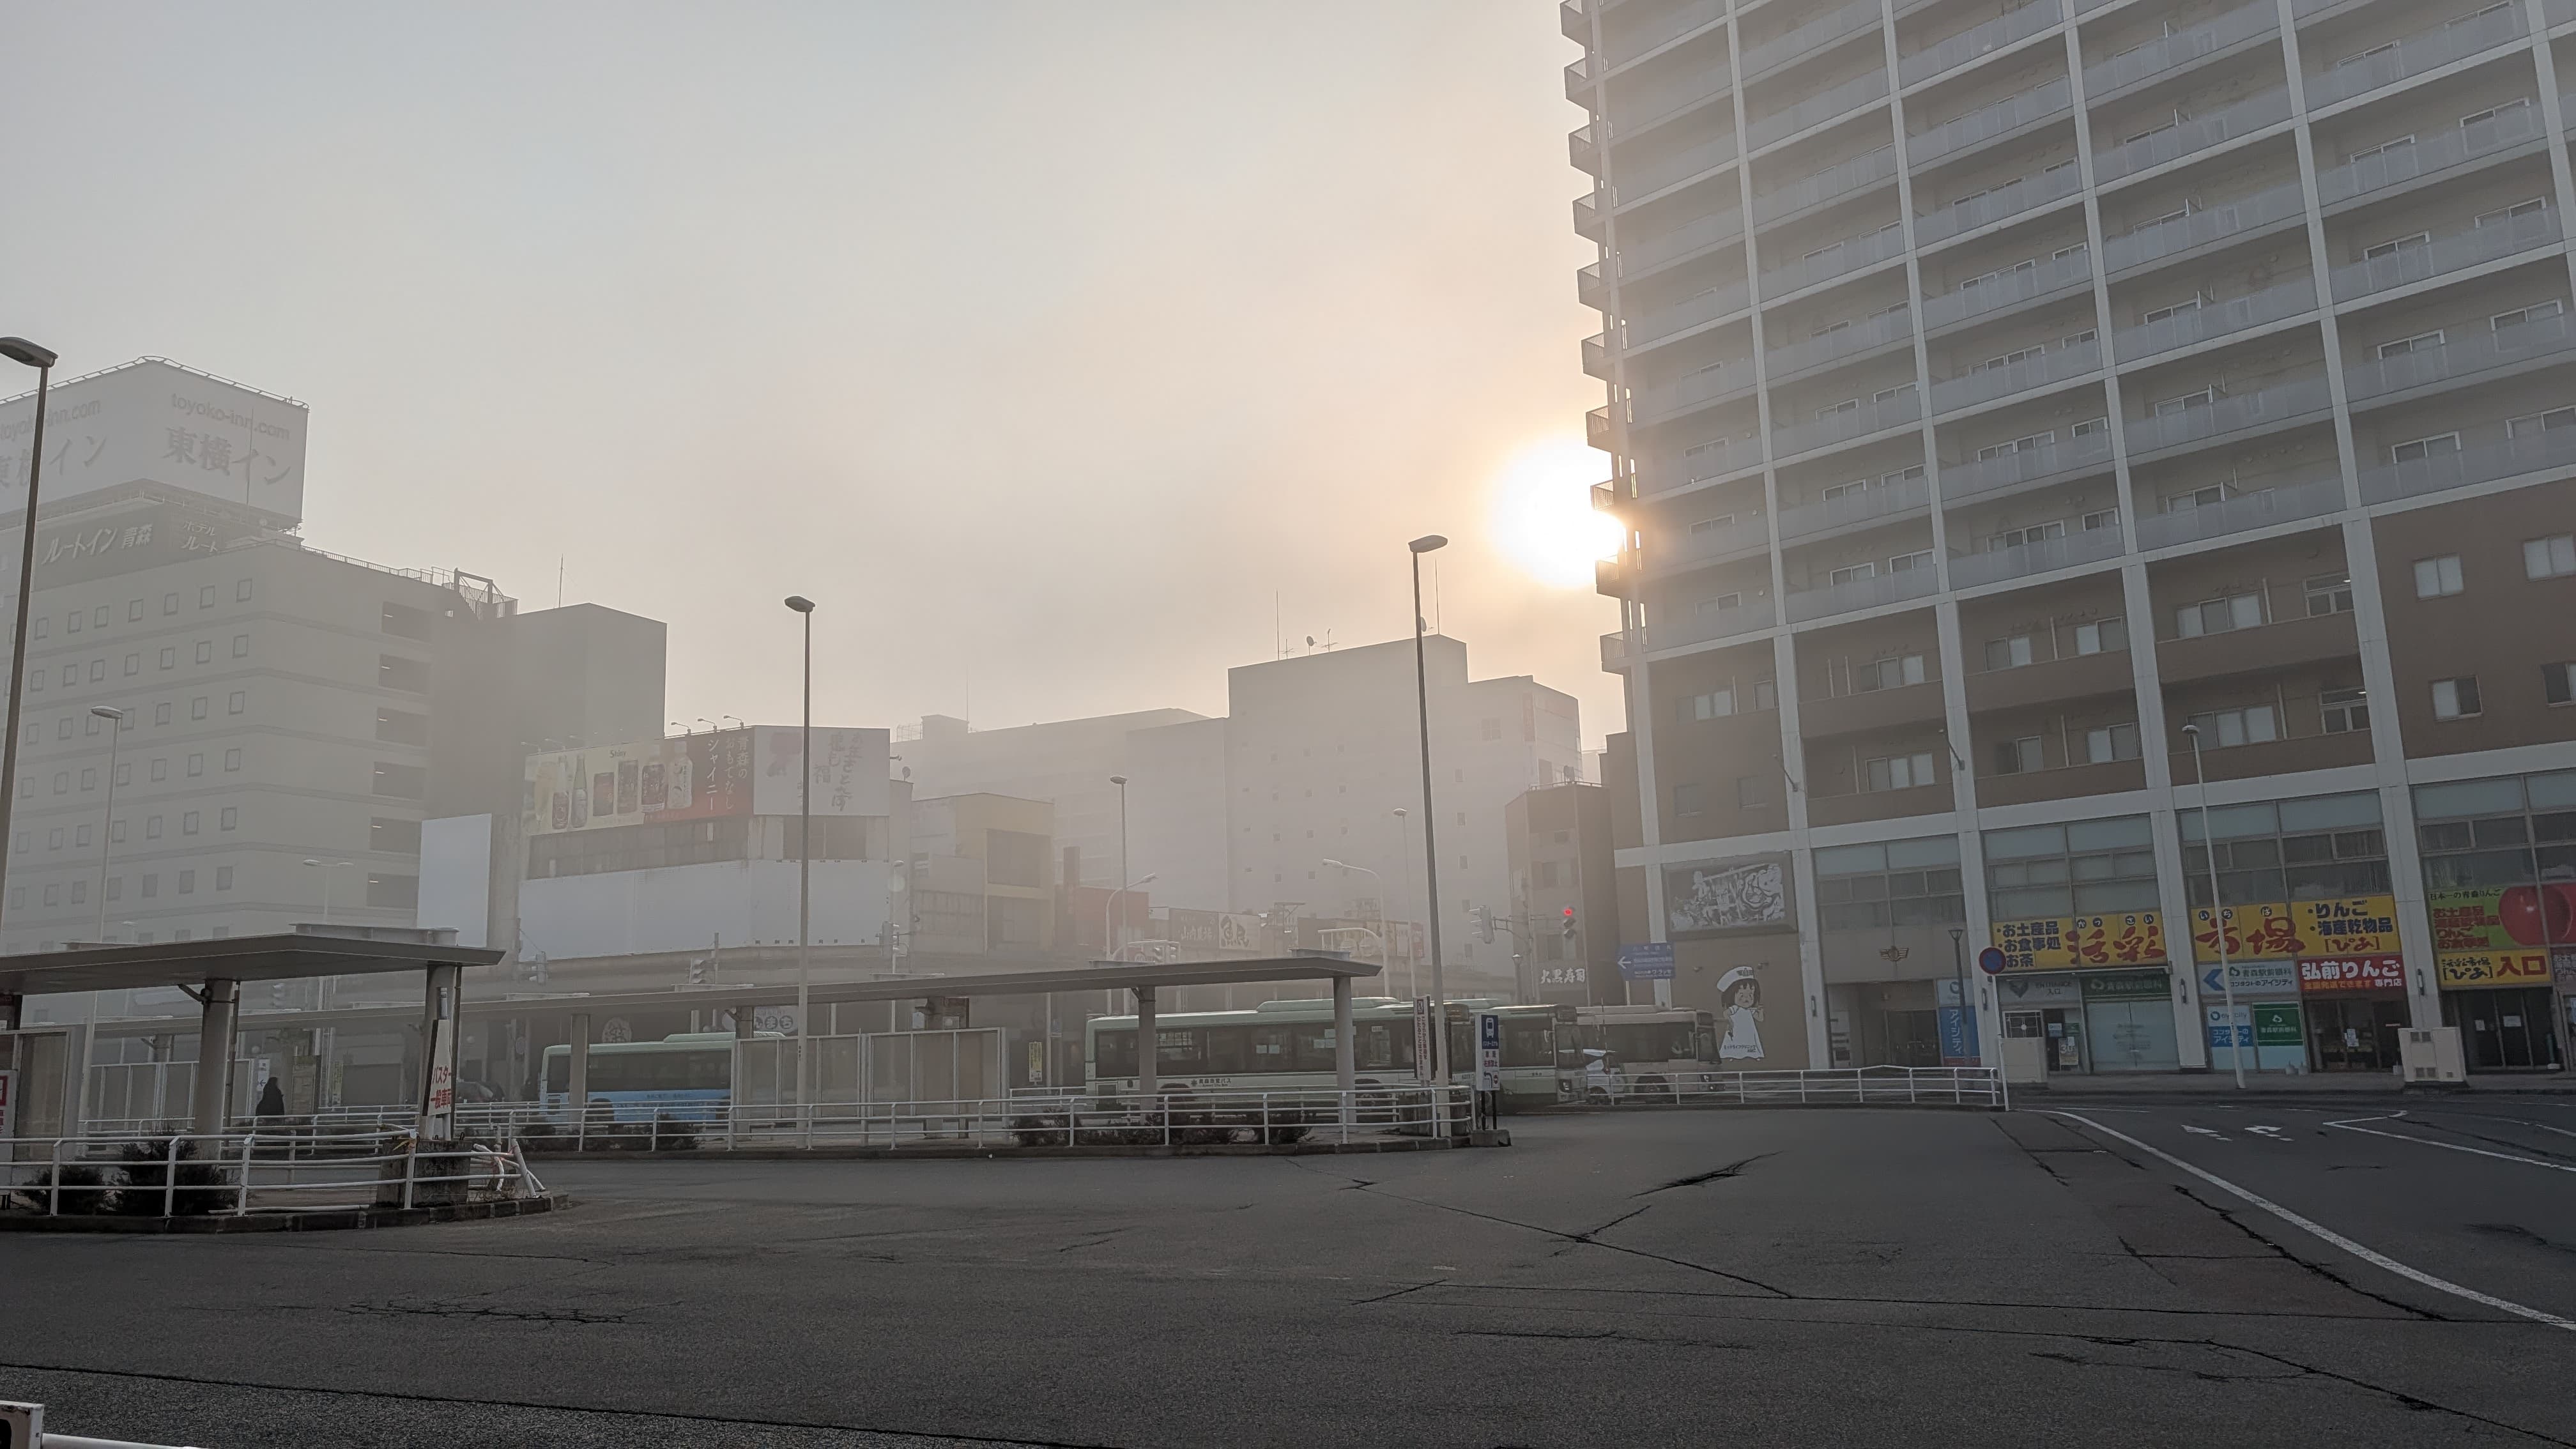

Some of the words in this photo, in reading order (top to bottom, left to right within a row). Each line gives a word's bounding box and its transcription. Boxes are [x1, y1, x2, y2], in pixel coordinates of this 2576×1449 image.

[171, 393, 291, 441] toyoko-inn.com
[161, 426, 292, 486] 東横イン
[41, 526, 118, 566] ルートイン
[737, 735, 750, 779] 青森の
[706, 739, 720, 813] シャイニー
[723, 736, 735, 810] おもてなし
[2315, 899, 2368, 919] りんご
[2002, 921, 2059, 938] お土産品
[2317, 917, 2393, 936] 海産乾物品
[2004, 936, 2062, 953] お食事処
[2006, 953, 2034, 968] お茶
[2301, 960, 2401, 980] 弘前りんご
[2496, 955, 2547, 977] 入口
[2375, 978, 2402, 987] 専門店
[433, 1065, 451, 1084] バスタ
